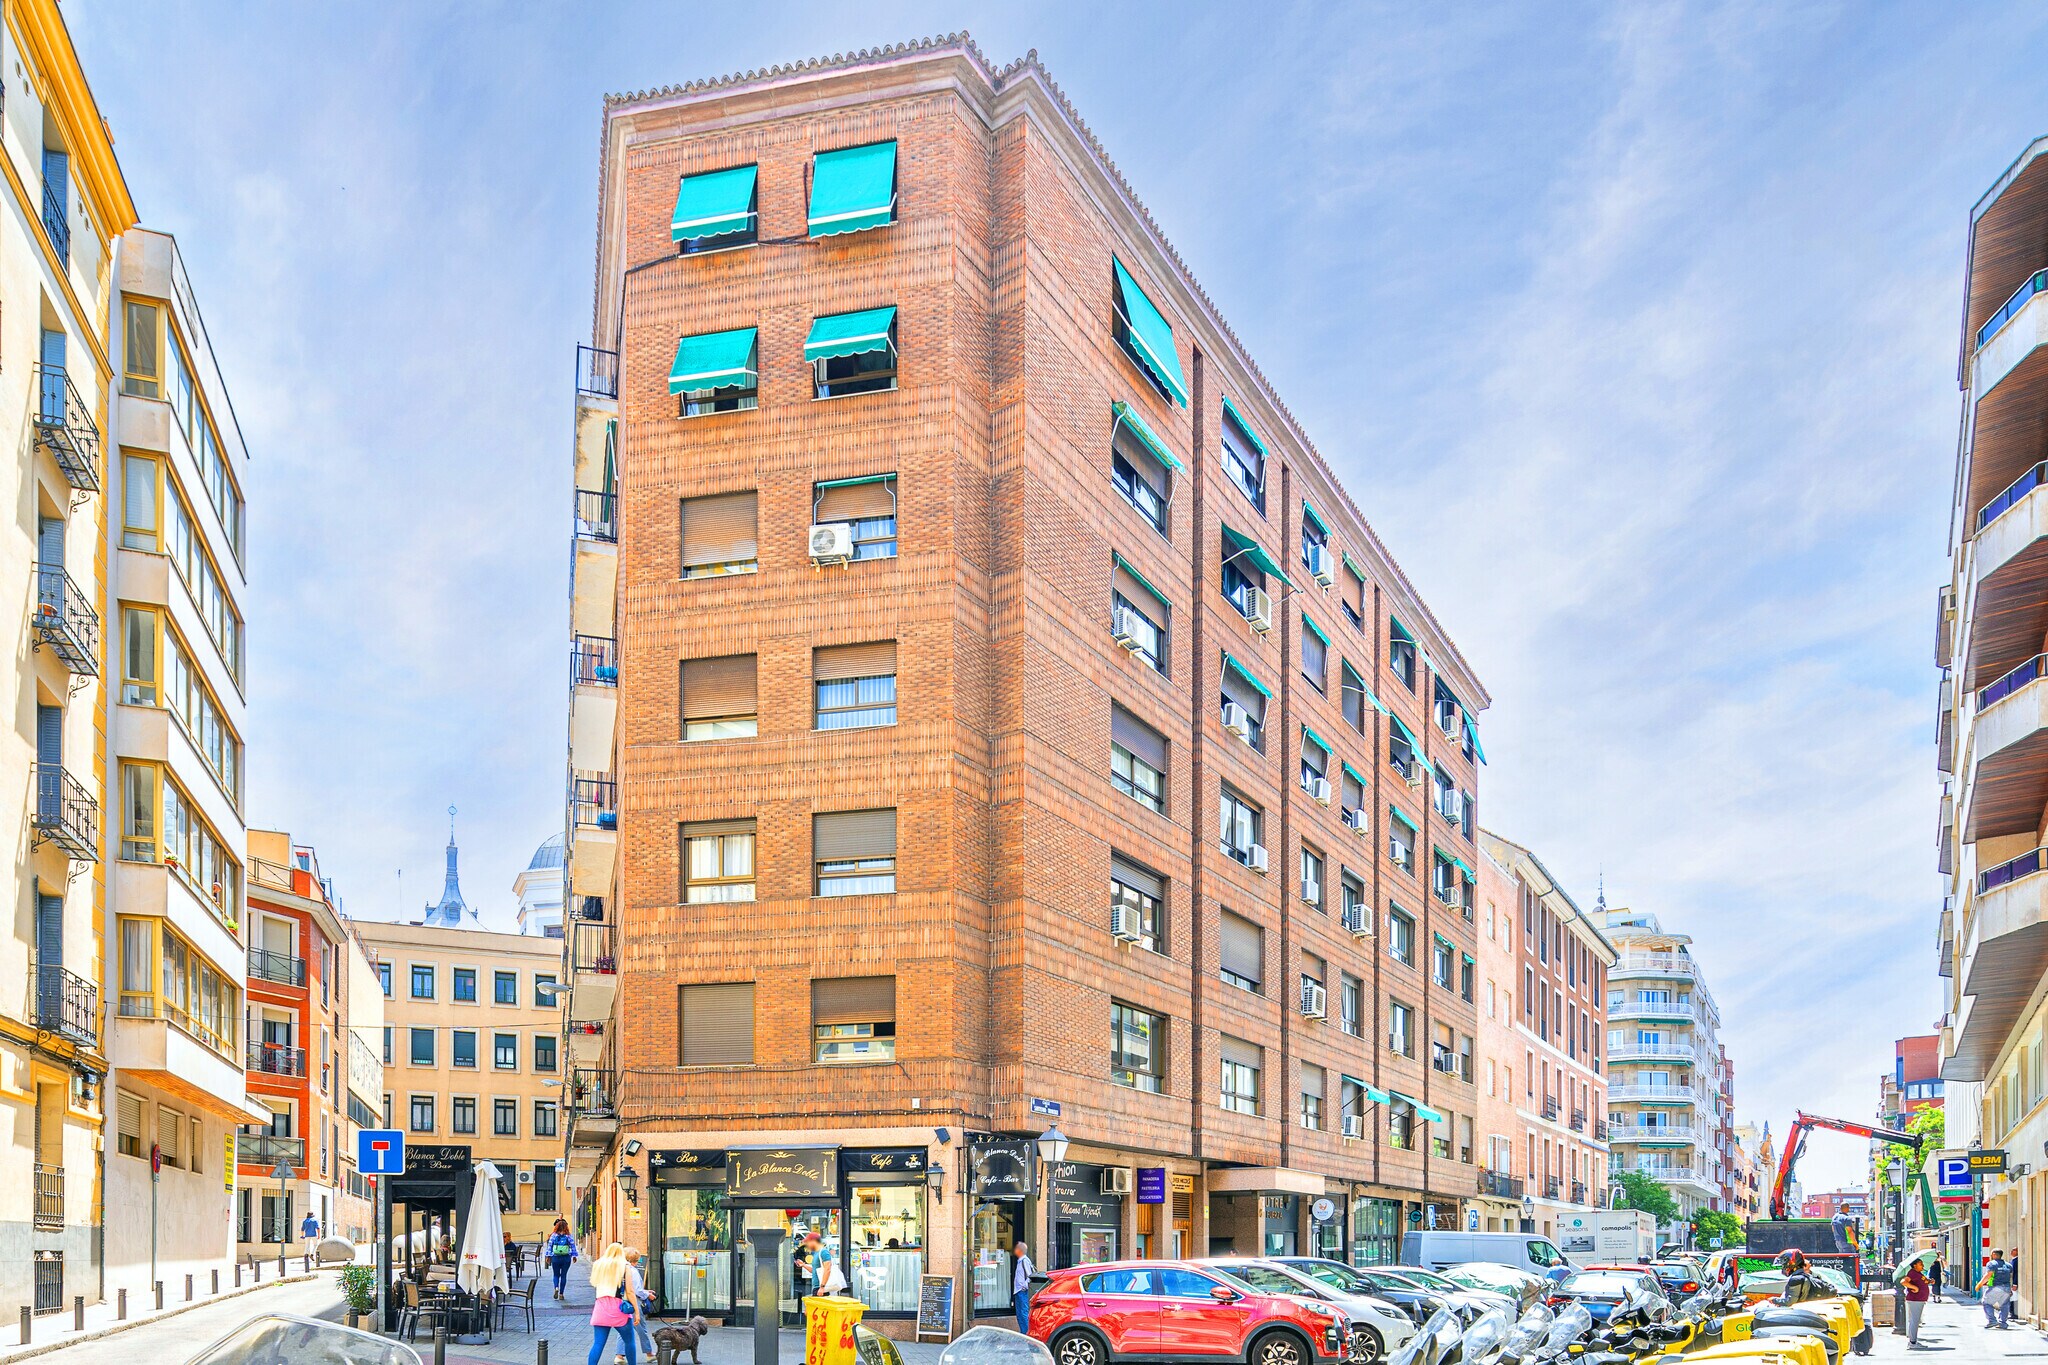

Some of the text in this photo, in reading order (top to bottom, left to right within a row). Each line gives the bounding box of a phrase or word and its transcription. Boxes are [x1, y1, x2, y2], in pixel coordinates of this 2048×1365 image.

[440, 1147, 466, 1160] Doble
[676, 1150, 699, 1163] Bar
[984, 1148, 1009, 1159] Blanca
[429, 1161, 452, 1169] Bar
[870, 1153, 894, 1170] Café
[1983, 1156, 2002, 1165] BM
[743, 1162, 820, 1182] La Blanca Doble
[1943, 1159, 1969, 1185] P
[980, 1174, 1020, 1187] Café Bar
[1054, 1184, 1077, 1196] dresser
[1811, 1258, 1844, 1267] Transportes
